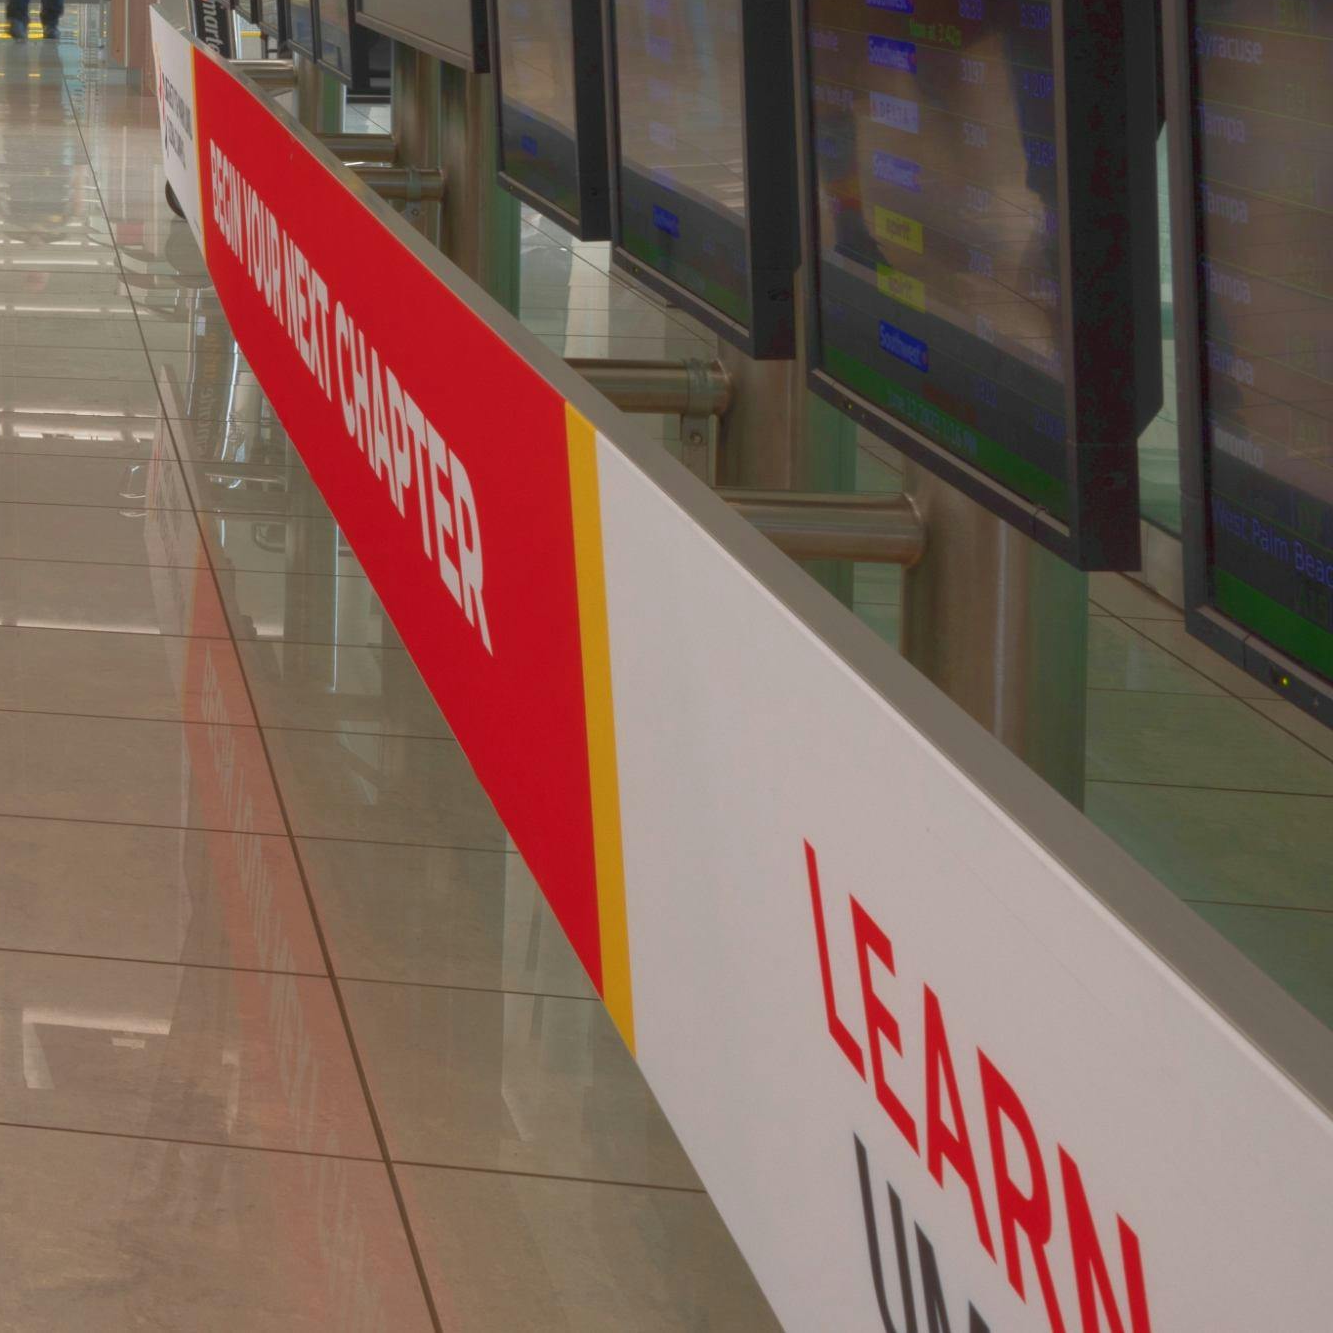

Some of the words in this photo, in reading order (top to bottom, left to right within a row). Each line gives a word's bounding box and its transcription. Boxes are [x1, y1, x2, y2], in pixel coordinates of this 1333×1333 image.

[1195, 26, 1263, 65] Syracuse
[1198, 102, 1245, 144] Tampa
[1203, 183, 1249, 224] Tampa
[1205, 261, 1251, 305] Tampa
[1207, 340, 1254, 385] Tampa
[210, 138, 244, 265] BEGIN
[242, 178, 284, 326] YOUR
[283, 229, 332, 403] NEXT
[335, 300, 494, 657] CHAPTER
[1252, 518, 1289, 562] Palm
[1293, 540, 1333, 587] Beac
[804, 838, 1151, 1333] LEARN
